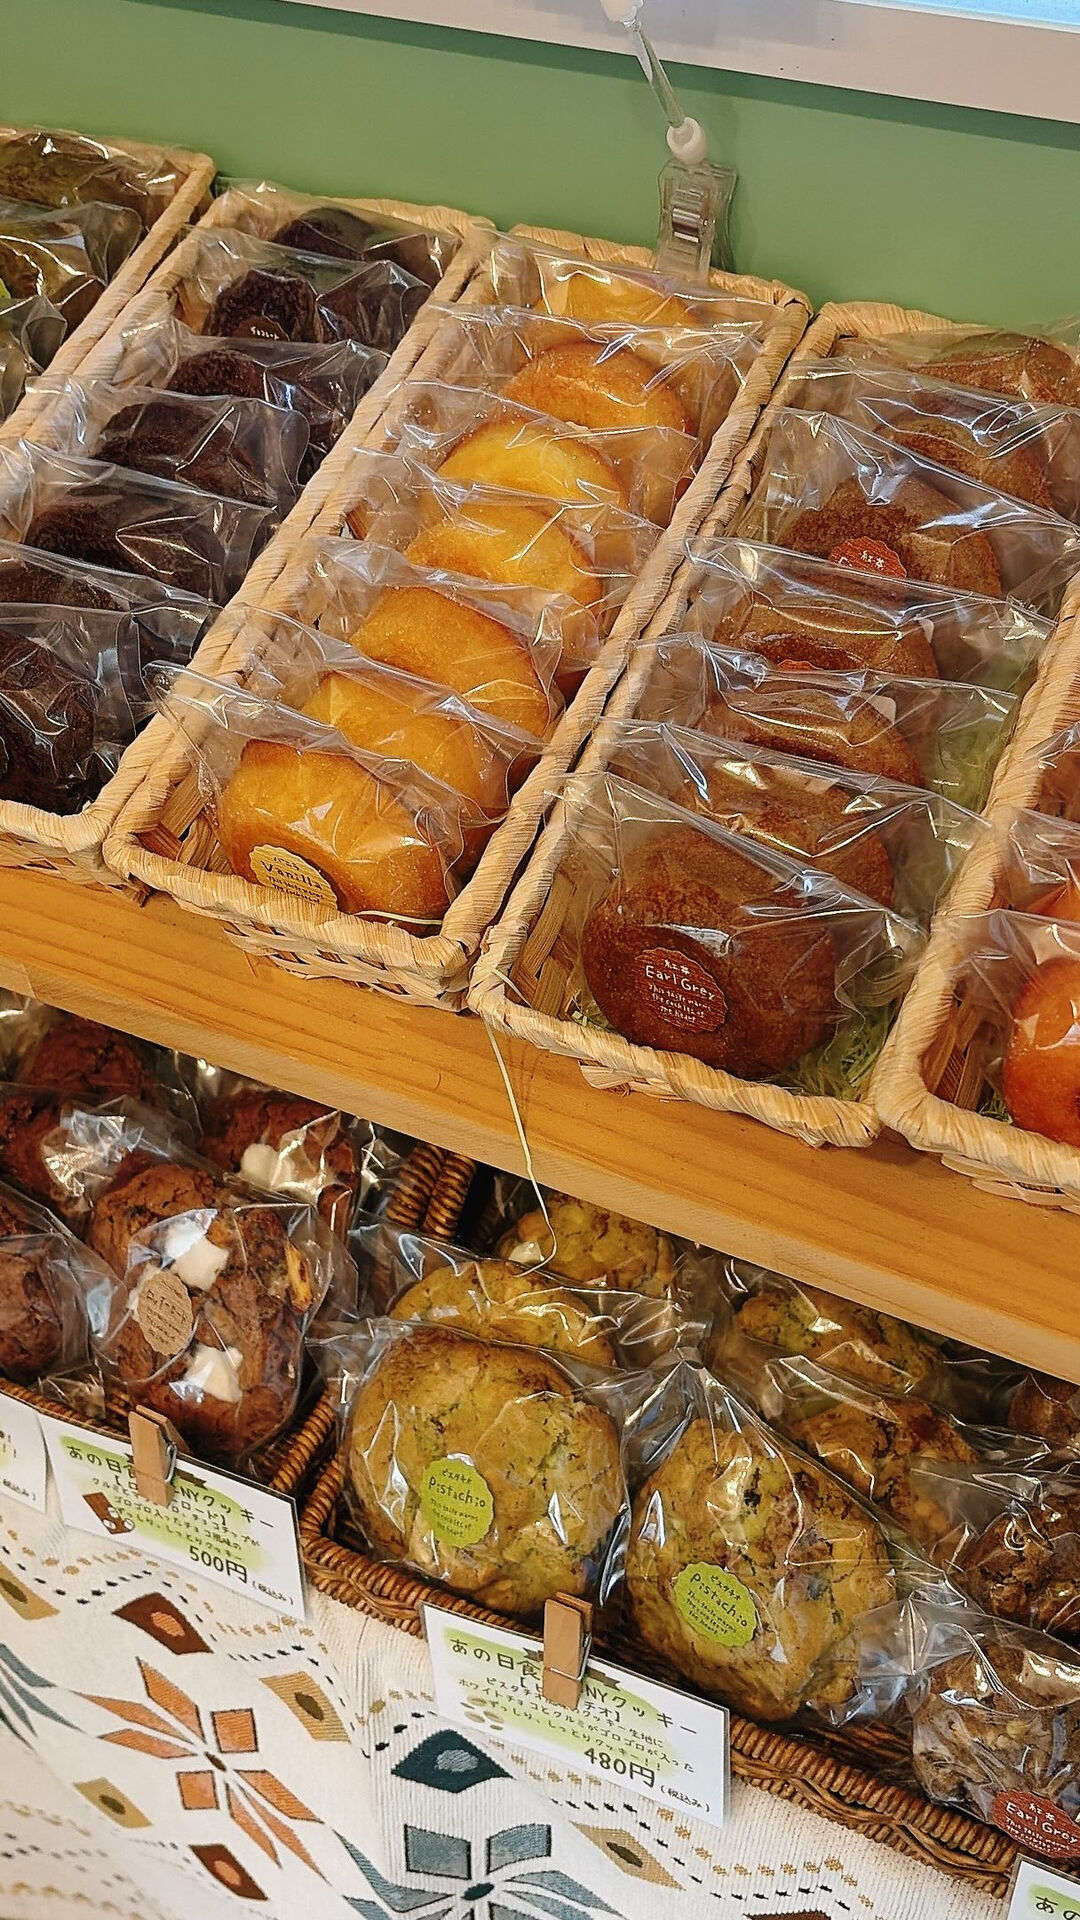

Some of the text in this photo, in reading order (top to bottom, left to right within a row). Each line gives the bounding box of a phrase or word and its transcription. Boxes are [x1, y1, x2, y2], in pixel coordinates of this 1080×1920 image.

[861, 550, 886, 571] 紅茶
[261, 860, 323, 890] Vanilla
[645, 964, 716, 1001] Earl Grey
[664, 959, 691, 976] 紅茶
[428, 1475, 486, 1508] Pistachio
[441, 1467, 473, 1485] ピスタチオ
[189, 1545, 248, 1584] 500円
[690, 1573, 748, 1627] Pistachio
[710, 1575, 742, 1601] ピスタチオ
[583, 1747, 656, 1788] 480円
[1006, 1801, 1038, 1826] Earl
[1041, 1822, 1078, 1844] Grey
